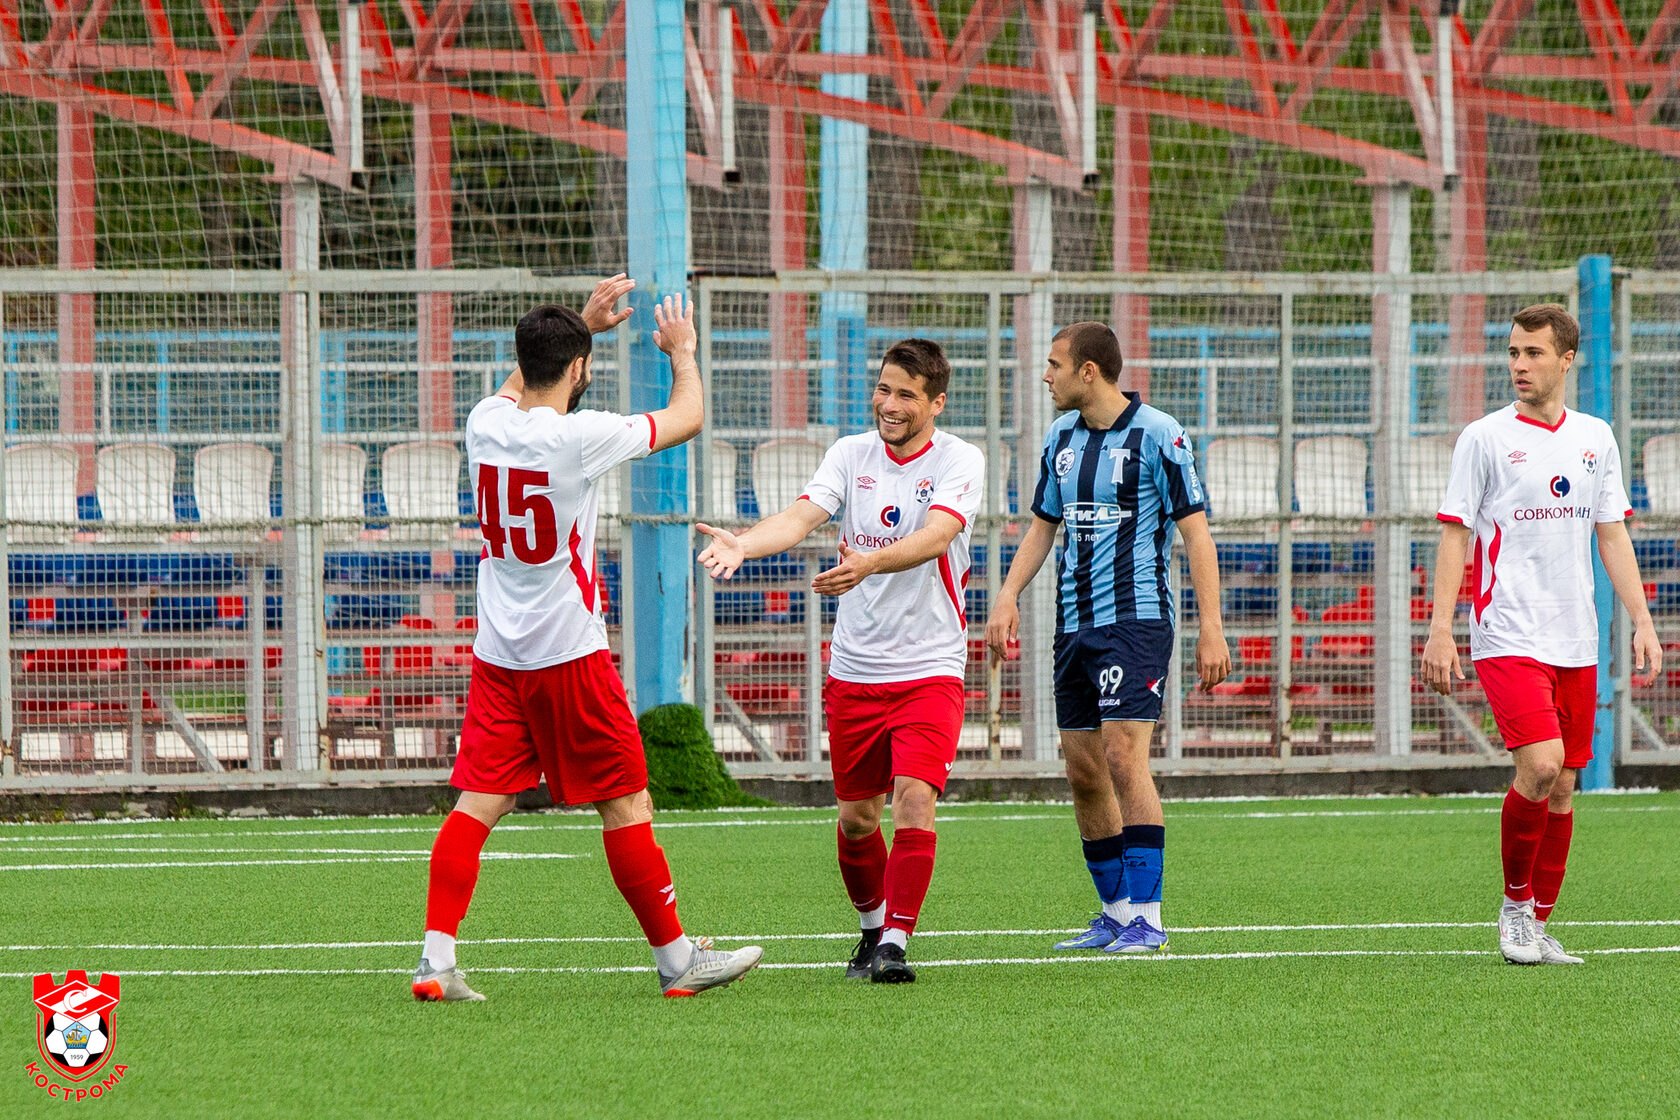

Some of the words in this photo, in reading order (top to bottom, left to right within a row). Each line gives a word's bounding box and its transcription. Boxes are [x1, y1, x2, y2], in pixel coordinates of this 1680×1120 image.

[477, 463, 557, 565] 45
[1514, 507, 1591, 521] СОВКОМАН
[1099, 665, 1123, 696] 99
